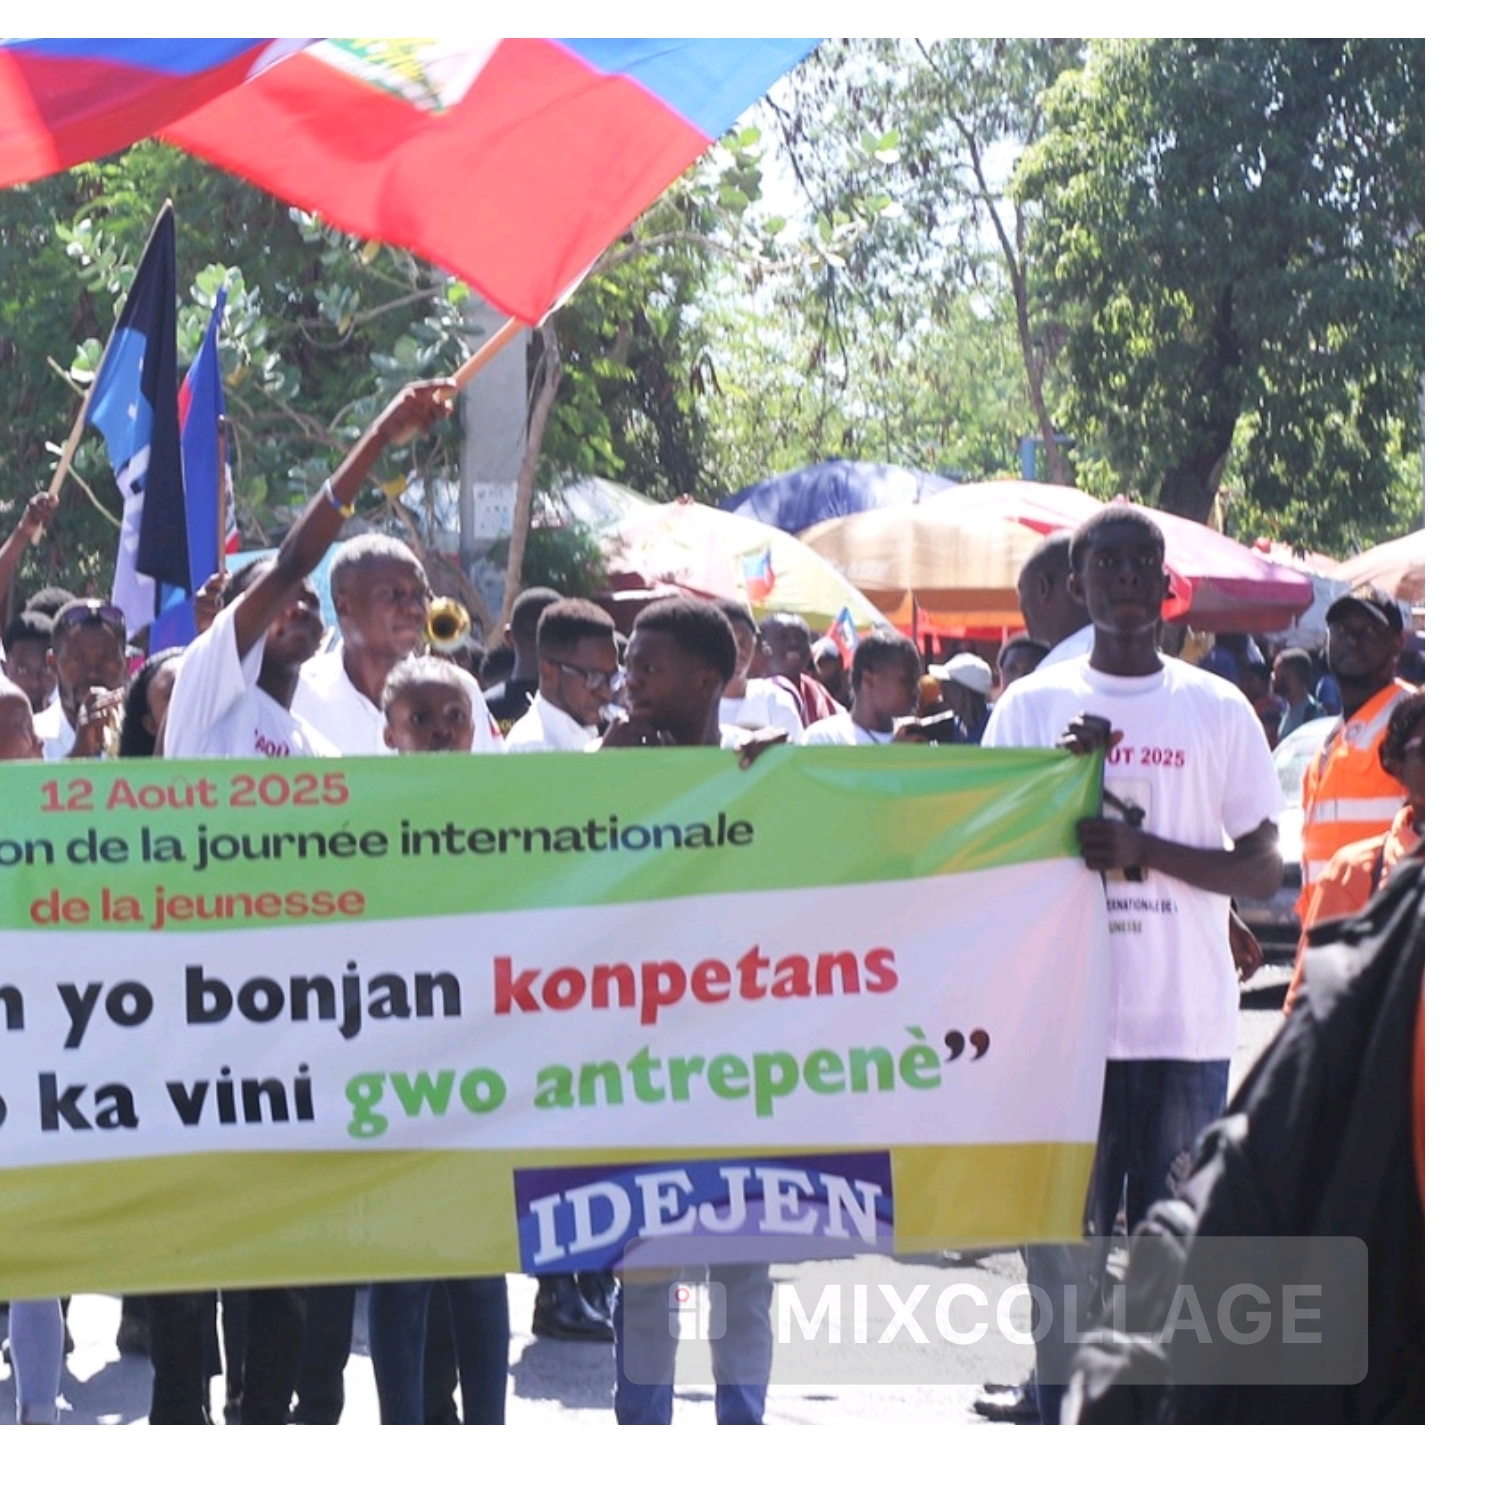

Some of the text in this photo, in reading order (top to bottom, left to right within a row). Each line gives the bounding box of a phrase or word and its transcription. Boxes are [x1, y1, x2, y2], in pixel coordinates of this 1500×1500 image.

[1140, 746, 1186, 769] 2025
[41, 778, 95, 813] 12
[228, 772, 350, 809] 2025
[66, 827, 130, 865] de
[141, 825, 186, 863] la
[193, 818, 390, 871] journée
[400, 812, 755, 858] internationale
[29, 885, 367, 931] de la jeunesse
[56, 978, 155, 1051] yo
[185, 960, 462, 1040] bonjan
[493, 944, 900, 1026] konpetans
[37, 1070, 140, 1133] ka
[165, 1062, 316, 1127] vini
[344, 1066, 508, 1140] gwo
[530, 1165, 883, 1264] IDEJEN
